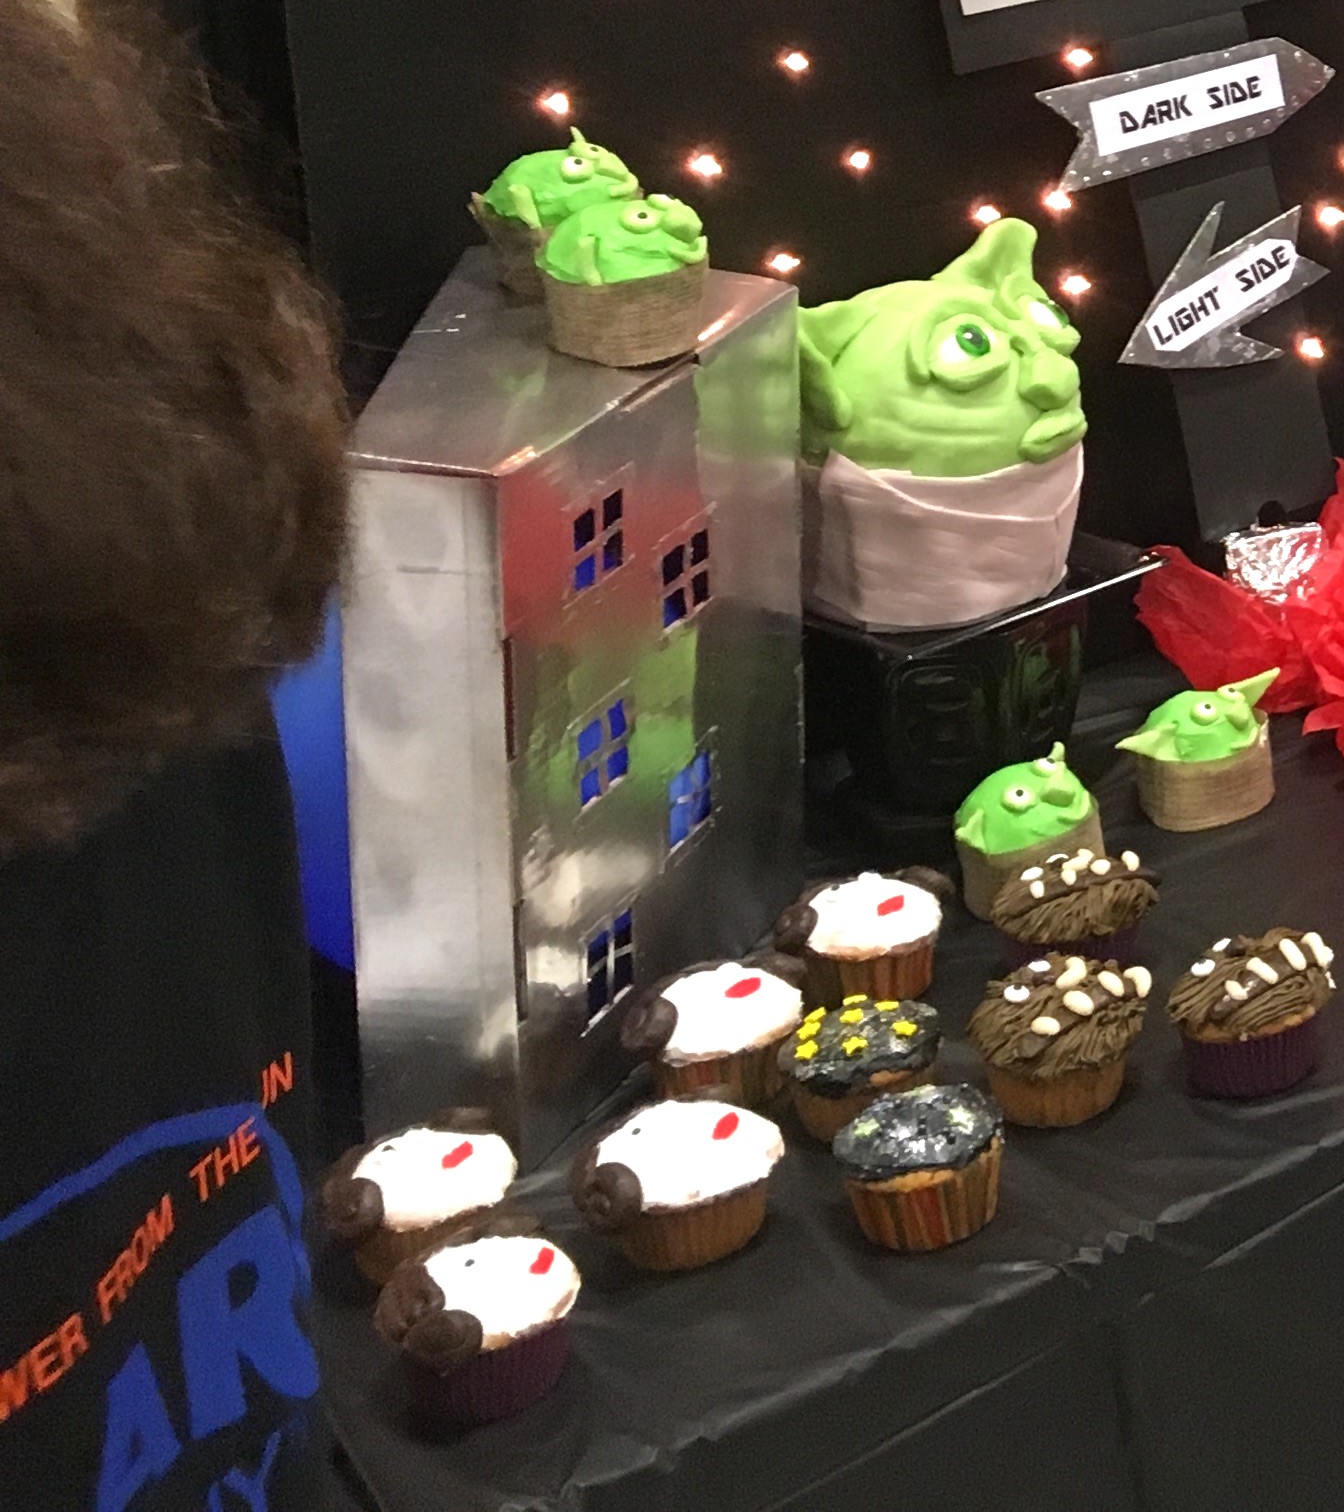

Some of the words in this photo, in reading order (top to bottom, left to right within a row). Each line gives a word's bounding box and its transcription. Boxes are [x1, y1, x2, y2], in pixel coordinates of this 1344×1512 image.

[1120, 96, 1191, 133] DARK
[1208, 77, 1261, 109] SIDE
[1154, 287, 1219, 344] LIGHT
[1236, 246, 1289, 291] SIDE
[97, 1194, 174, 1323] FROM
[190, 1116, 260, 1199] THE
